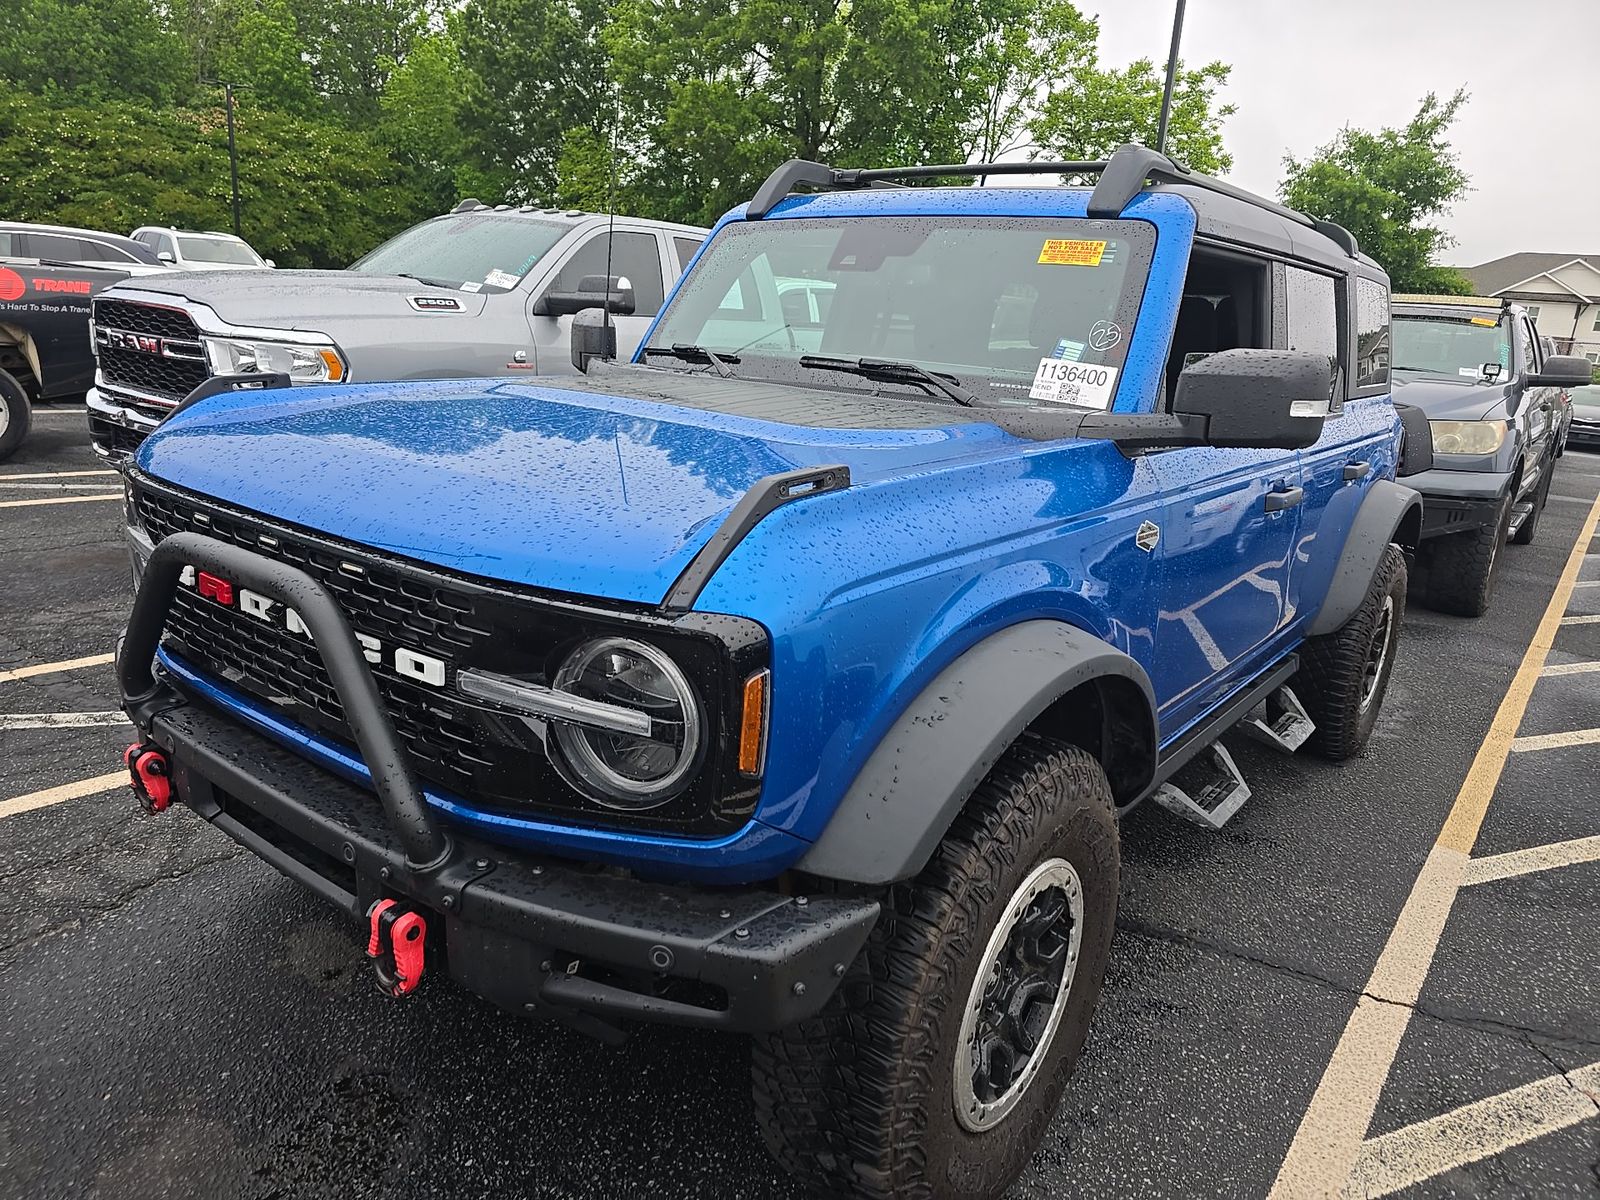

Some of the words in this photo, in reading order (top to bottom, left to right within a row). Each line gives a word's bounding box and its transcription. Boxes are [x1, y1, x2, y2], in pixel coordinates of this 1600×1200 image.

[32, 278, 91, 294] TRANE
[7, 303, 28, 311] Hard
[30, 303, 39, 311] To
[41, 304, 59, 313] Stop
[69, 305, 91, 314] Trane
[1092, 325, 1118, 347] 25
[1041, 363, 1108, 387] 1136400
